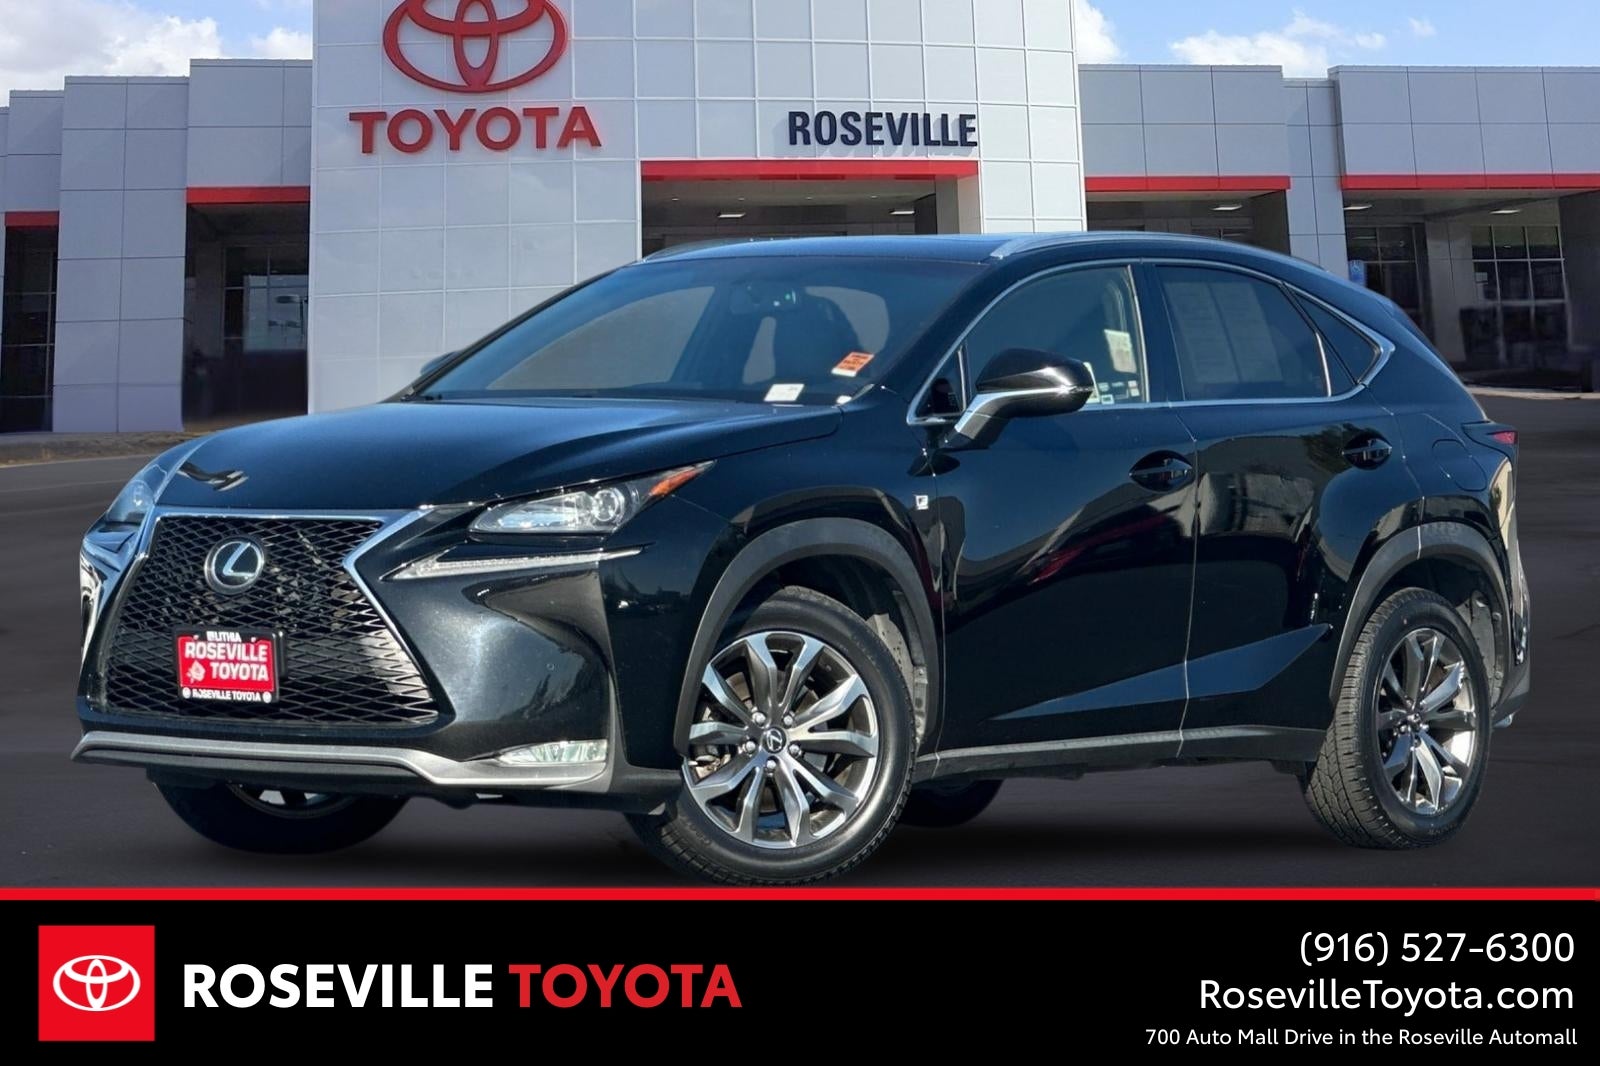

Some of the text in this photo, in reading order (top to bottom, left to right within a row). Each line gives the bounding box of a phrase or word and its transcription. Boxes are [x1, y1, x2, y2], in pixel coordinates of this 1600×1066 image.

[349, 106, 602, 154] TOYOTA
[788, 110, 978, 147] ROSEVILLE
[215, 631, 242, 643] LITHIA
[185, 641, 268, 662] ROSEVILLE
[210, 662, 269, 681] TOYOTA
[192, 689, 261, 702] ROSEVILLE TOYOTA
